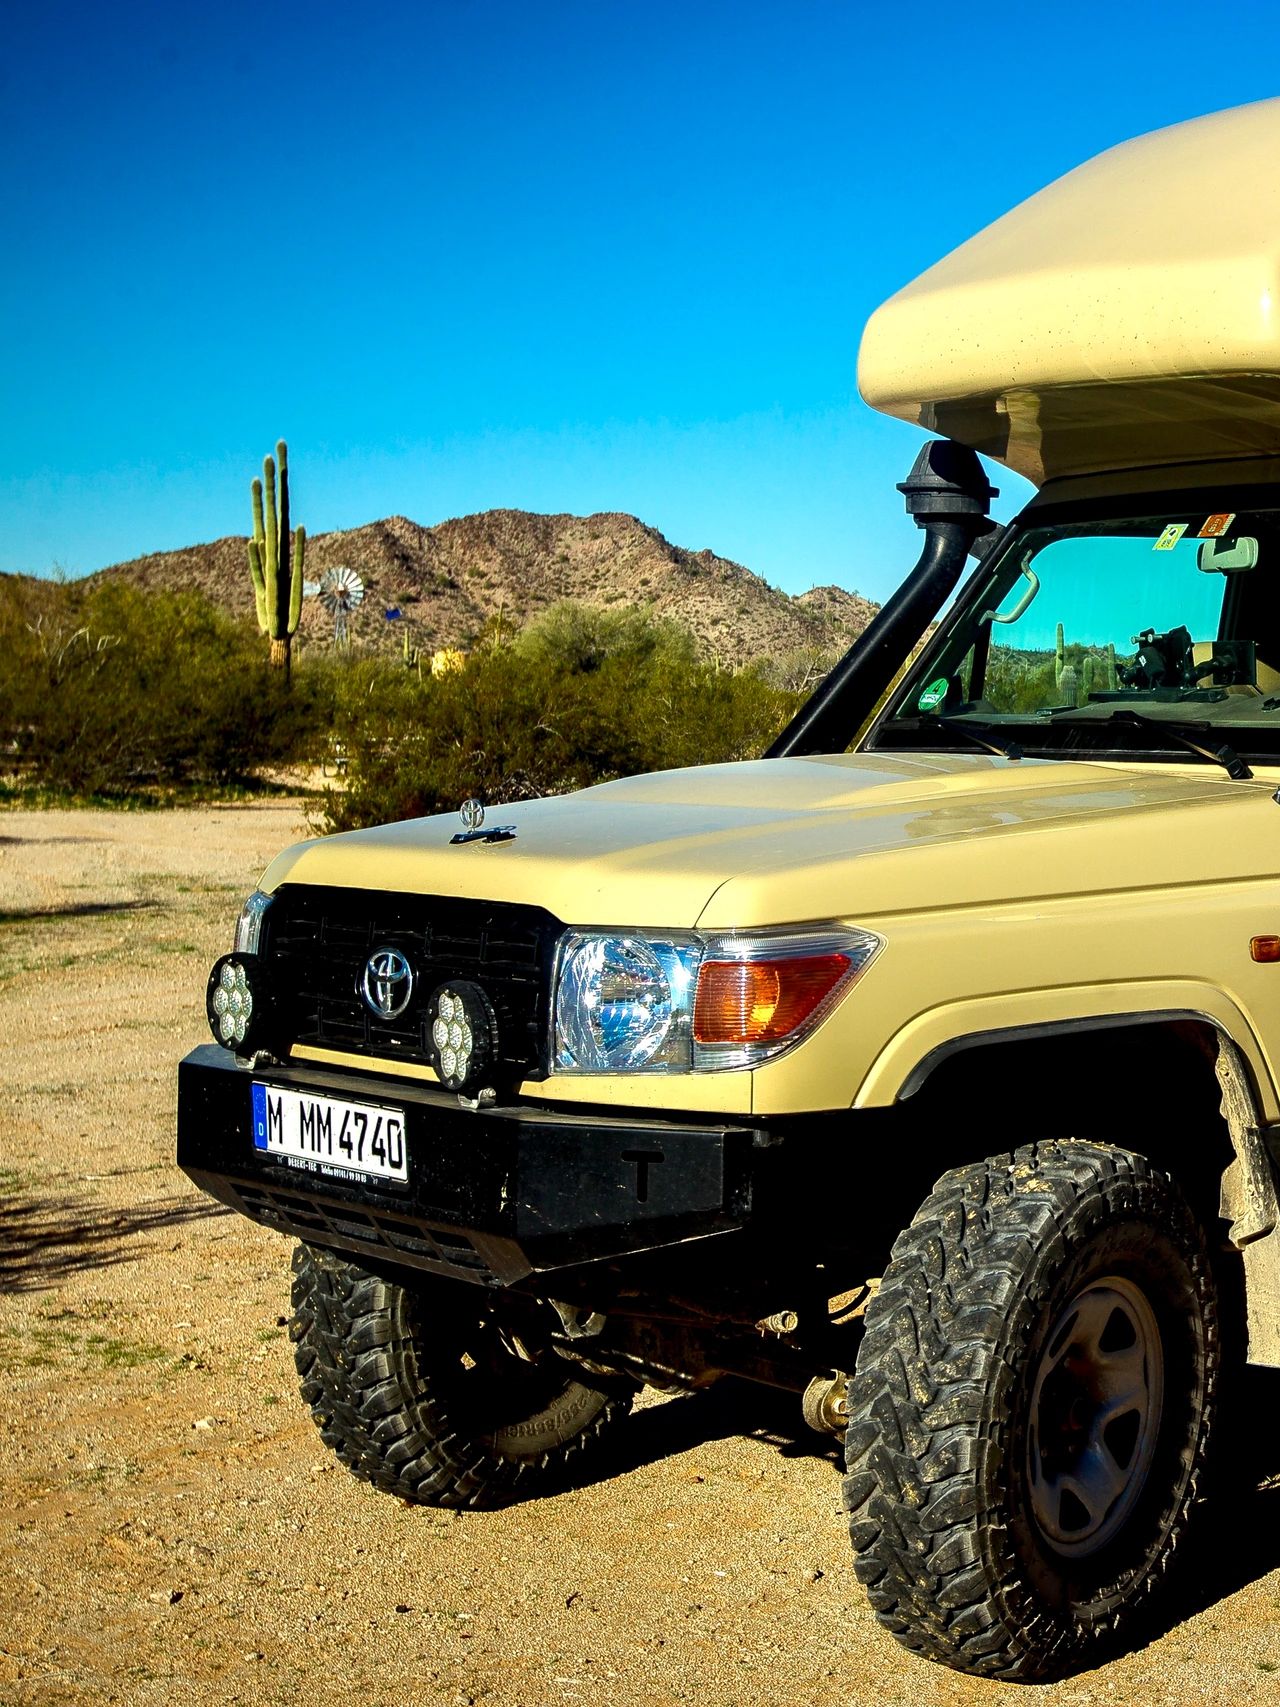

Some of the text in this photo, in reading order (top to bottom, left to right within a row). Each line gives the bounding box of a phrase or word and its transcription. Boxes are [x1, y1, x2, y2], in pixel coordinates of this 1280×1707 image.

[258, 1122, 265, 1137] D
[267, 1093, 404, 1170] M MM 4740
[287, 1156, 317, 1172] DESERT-TEC
